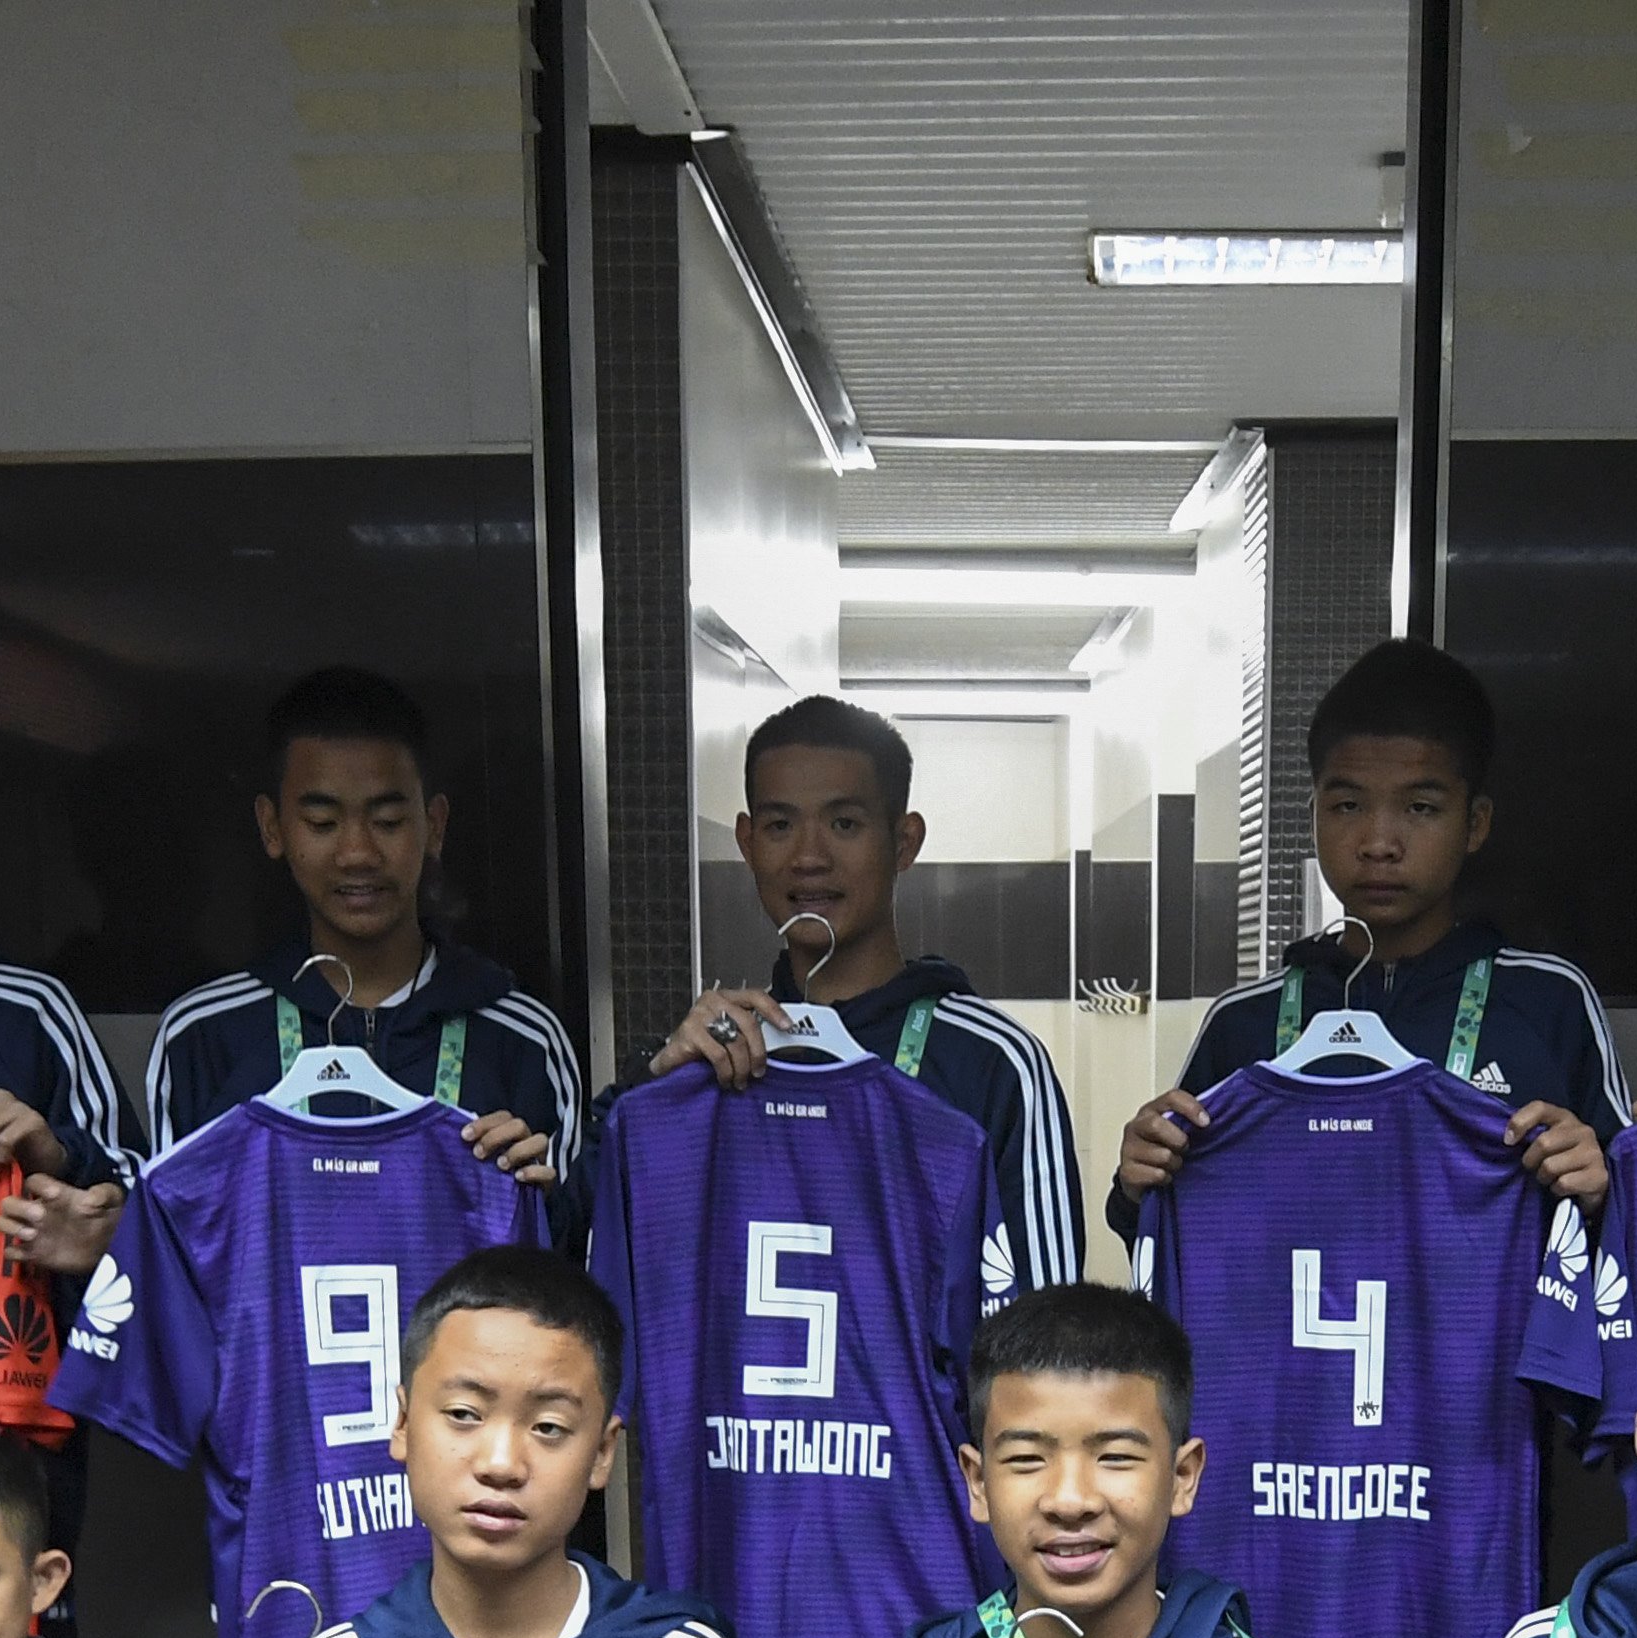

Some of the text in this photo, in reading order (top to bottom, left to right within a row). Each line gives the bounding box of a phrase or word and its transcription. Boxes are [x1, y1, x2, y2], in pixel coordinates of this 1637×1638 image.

[1308, 1118, 1319, 1132] EL
[313, 1157, 324, 1173] EL
[742, 1220, 839, 1398] 5
[1291, 1248, 1387, 1427] 4
[67, 1326, 121, 1363] WEI
[300, 1264, 403, 1447] 9
[316, 1472, 425, 1540] UTHA
[1251, 1461, 1431, 1522] SAENGDEE
